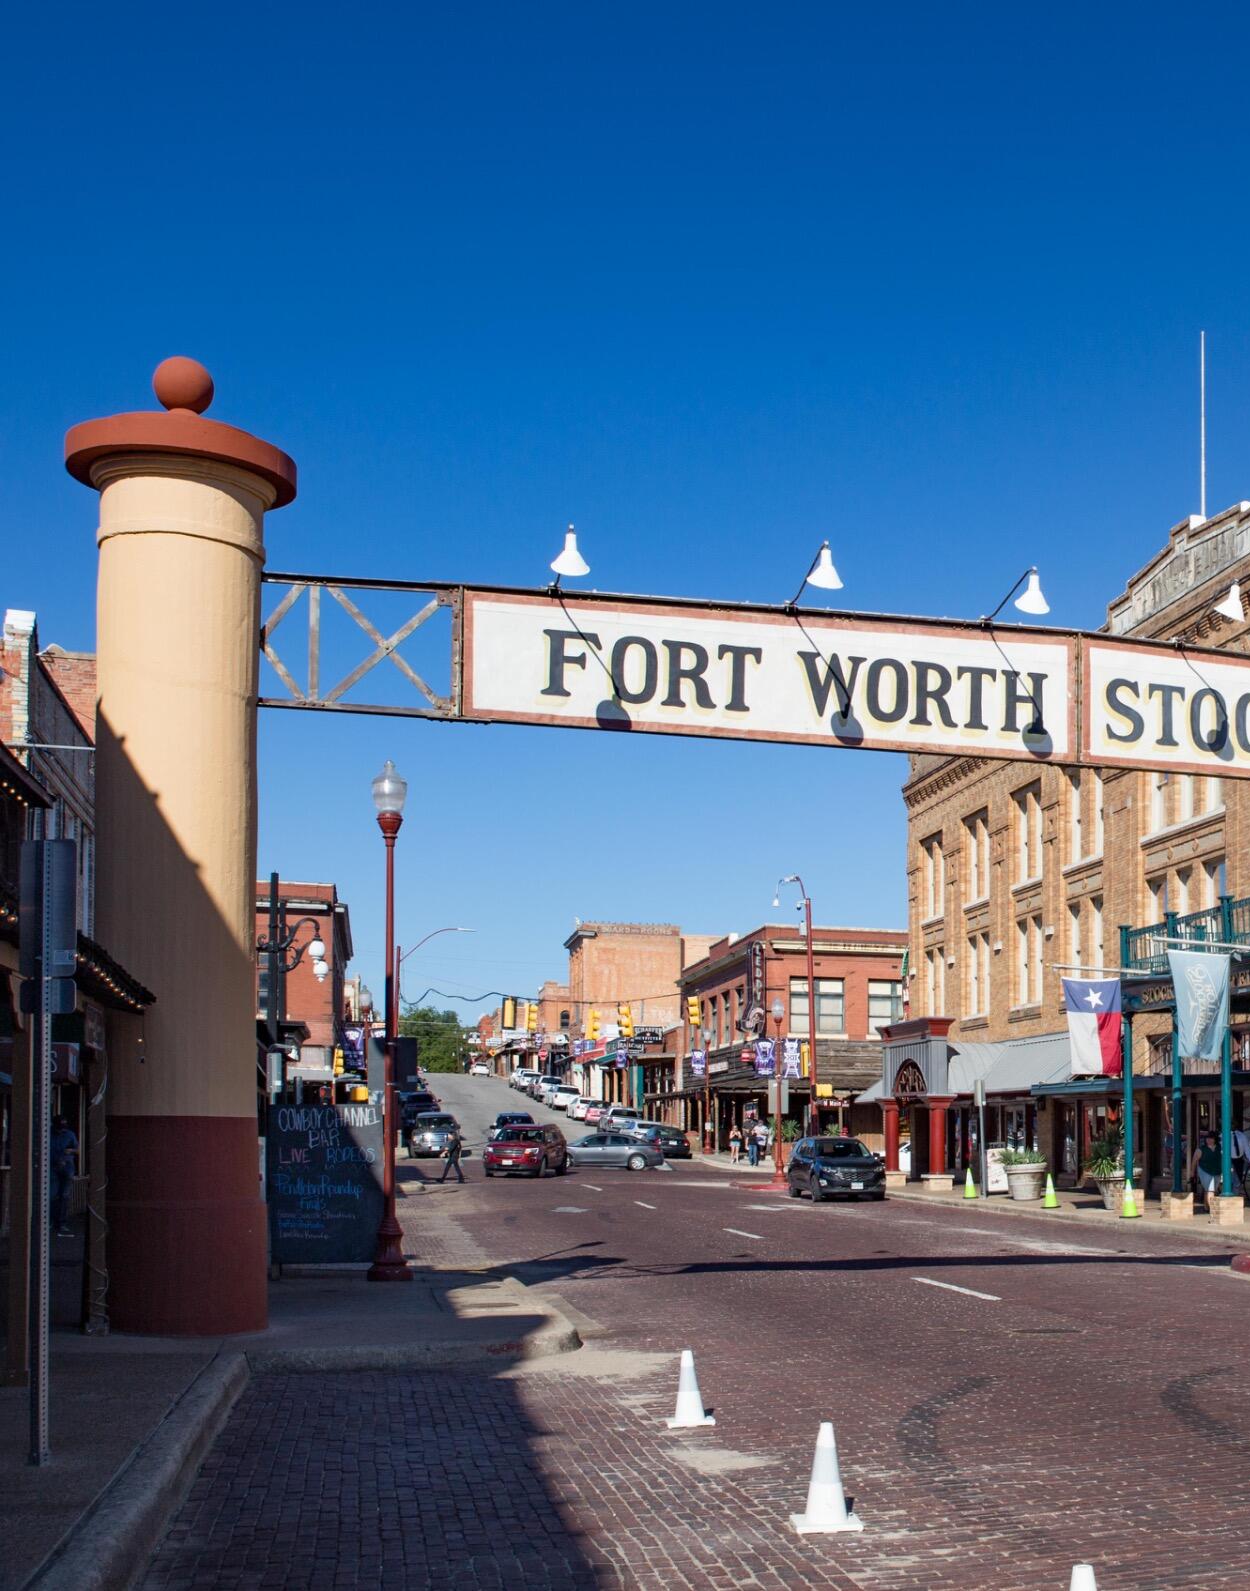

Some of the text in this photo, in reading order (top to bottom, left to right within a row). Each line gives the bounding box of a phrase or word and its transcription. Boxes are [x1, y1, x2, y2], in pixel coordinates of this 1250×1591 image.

[541, 628, 1050, 736] FORT WORTH
[278, 1108, 322, 1132] COWBOY
[308, 1128, 340, 1149] BAR
[279, 1146, 311, 1164] LIVE
